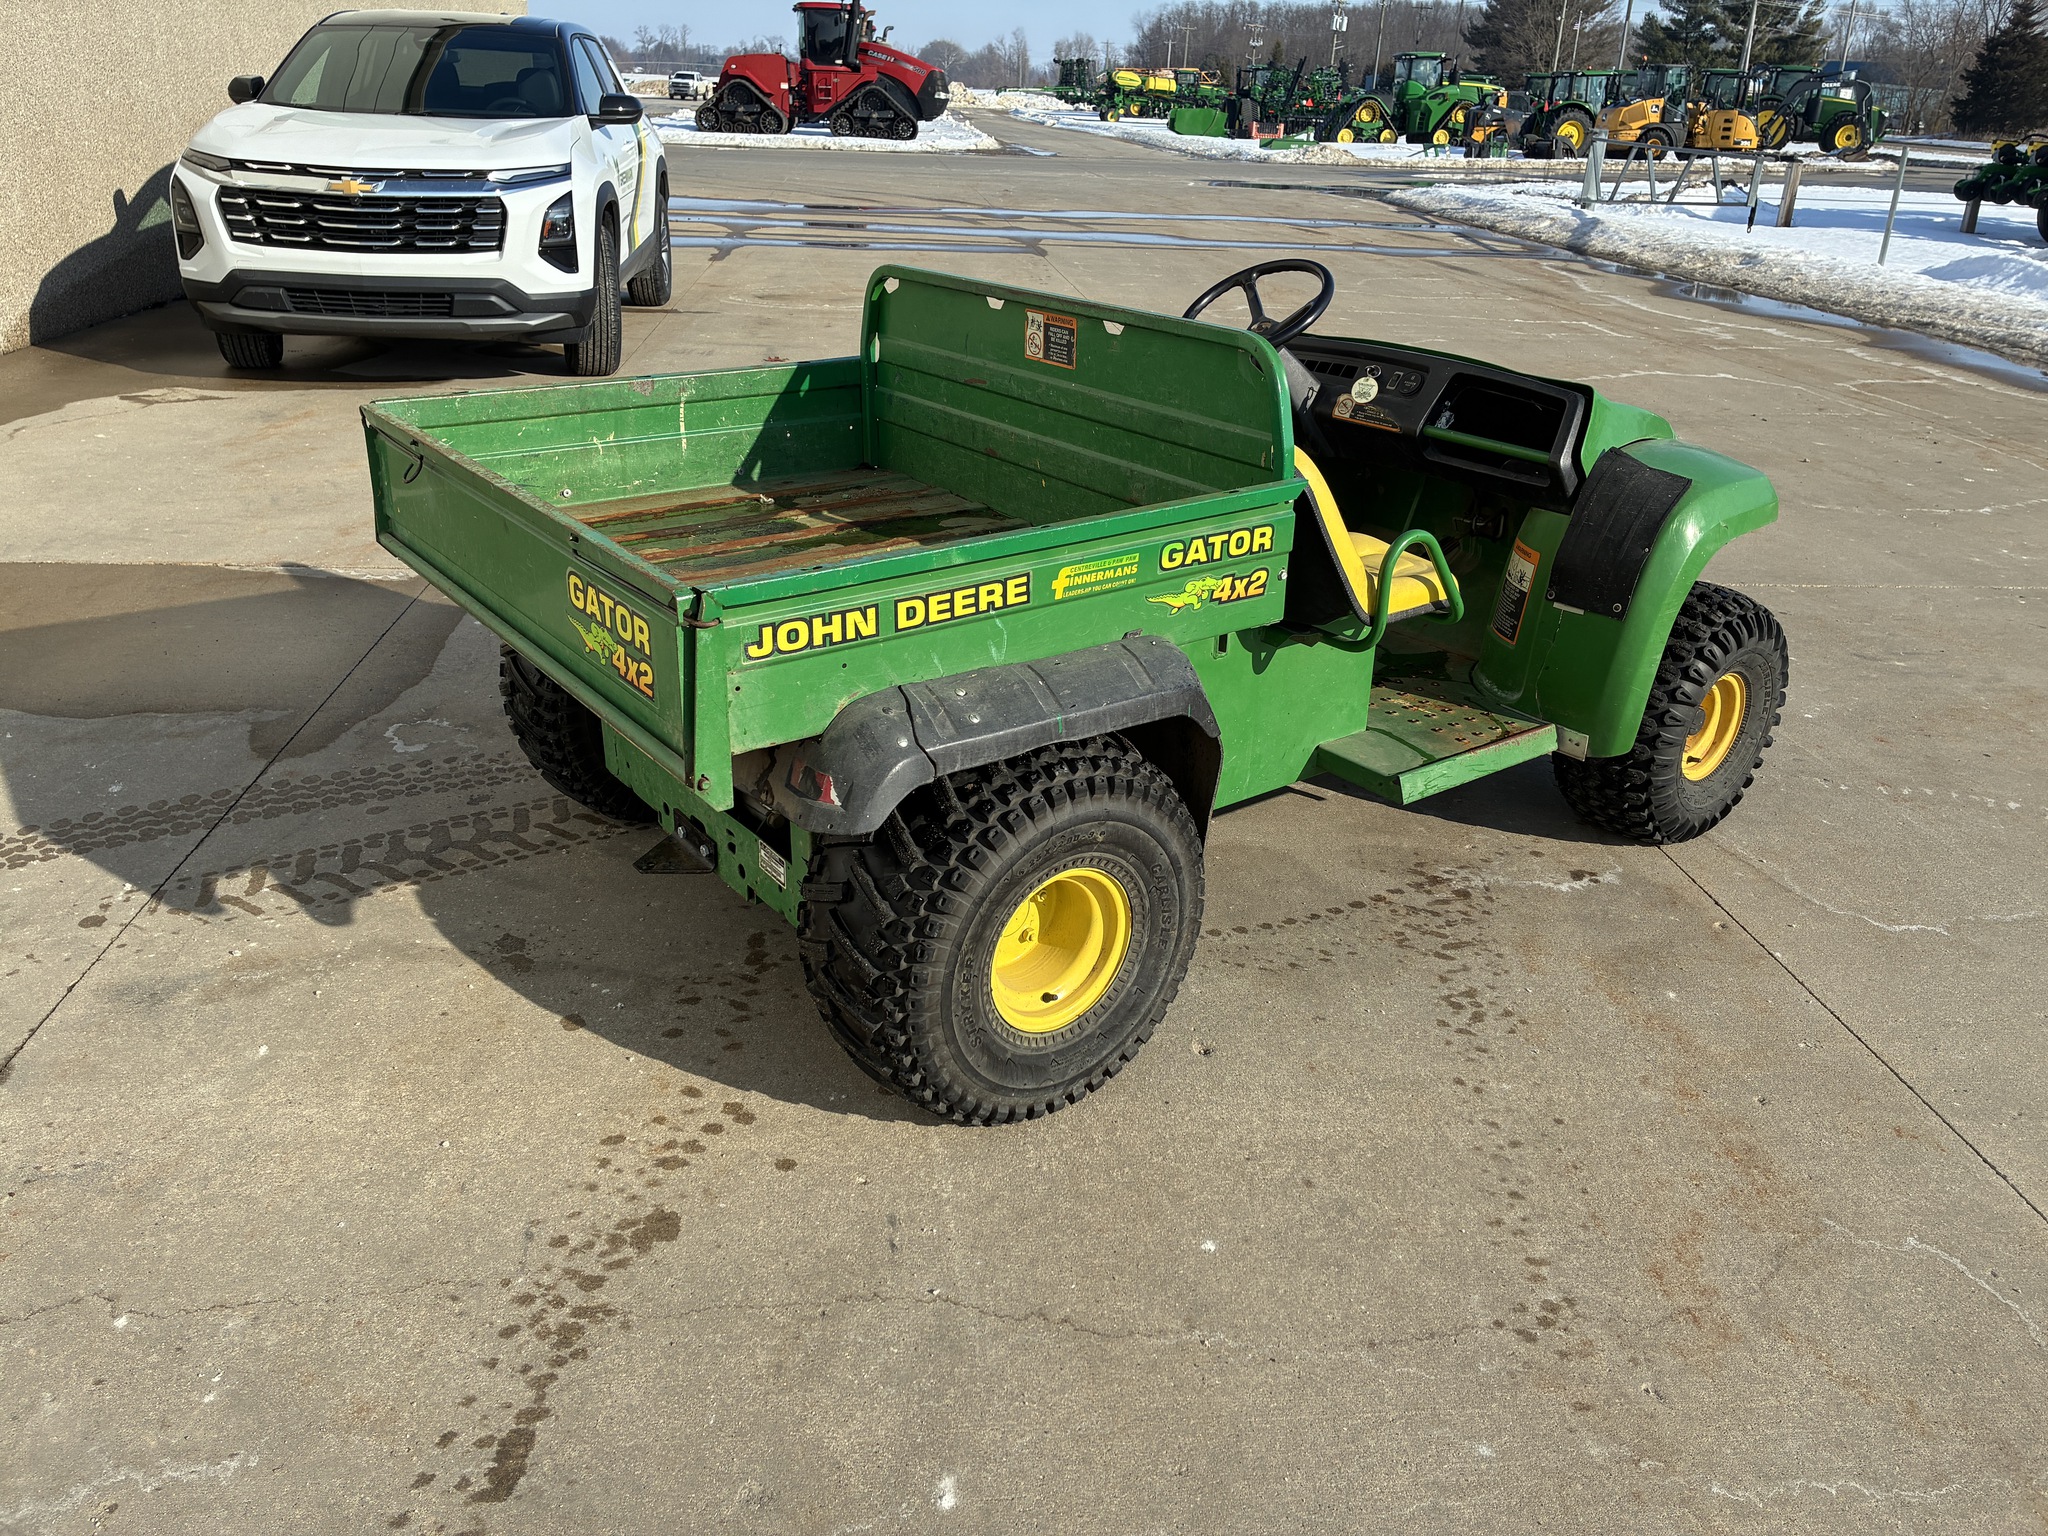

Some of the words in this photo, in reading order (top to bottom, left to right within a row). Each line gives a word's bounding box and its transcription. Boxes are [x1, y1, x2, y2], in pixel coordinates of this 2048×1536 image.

[867, 50, 887, 61] CASE
[1050, 316, 1073, 326] WARNING
[1069, 560, 1107, 573] CENTREVILLE
[1160, 524, 1274, 571] GATOR
[1092, 584, 1101, 592] YOU
[1211, 568, 1269, 603] 4x2
[568, 572, 652, 658] GATOR
[746, 605, 878, 660] JOHN
[896, 573, 1031, 632] DEERE
[612, 644, 654, 699] 4x2
[1150, 862, 1173, 950] CARLISLE
[960, 957, 982, 1048] STRYKER
